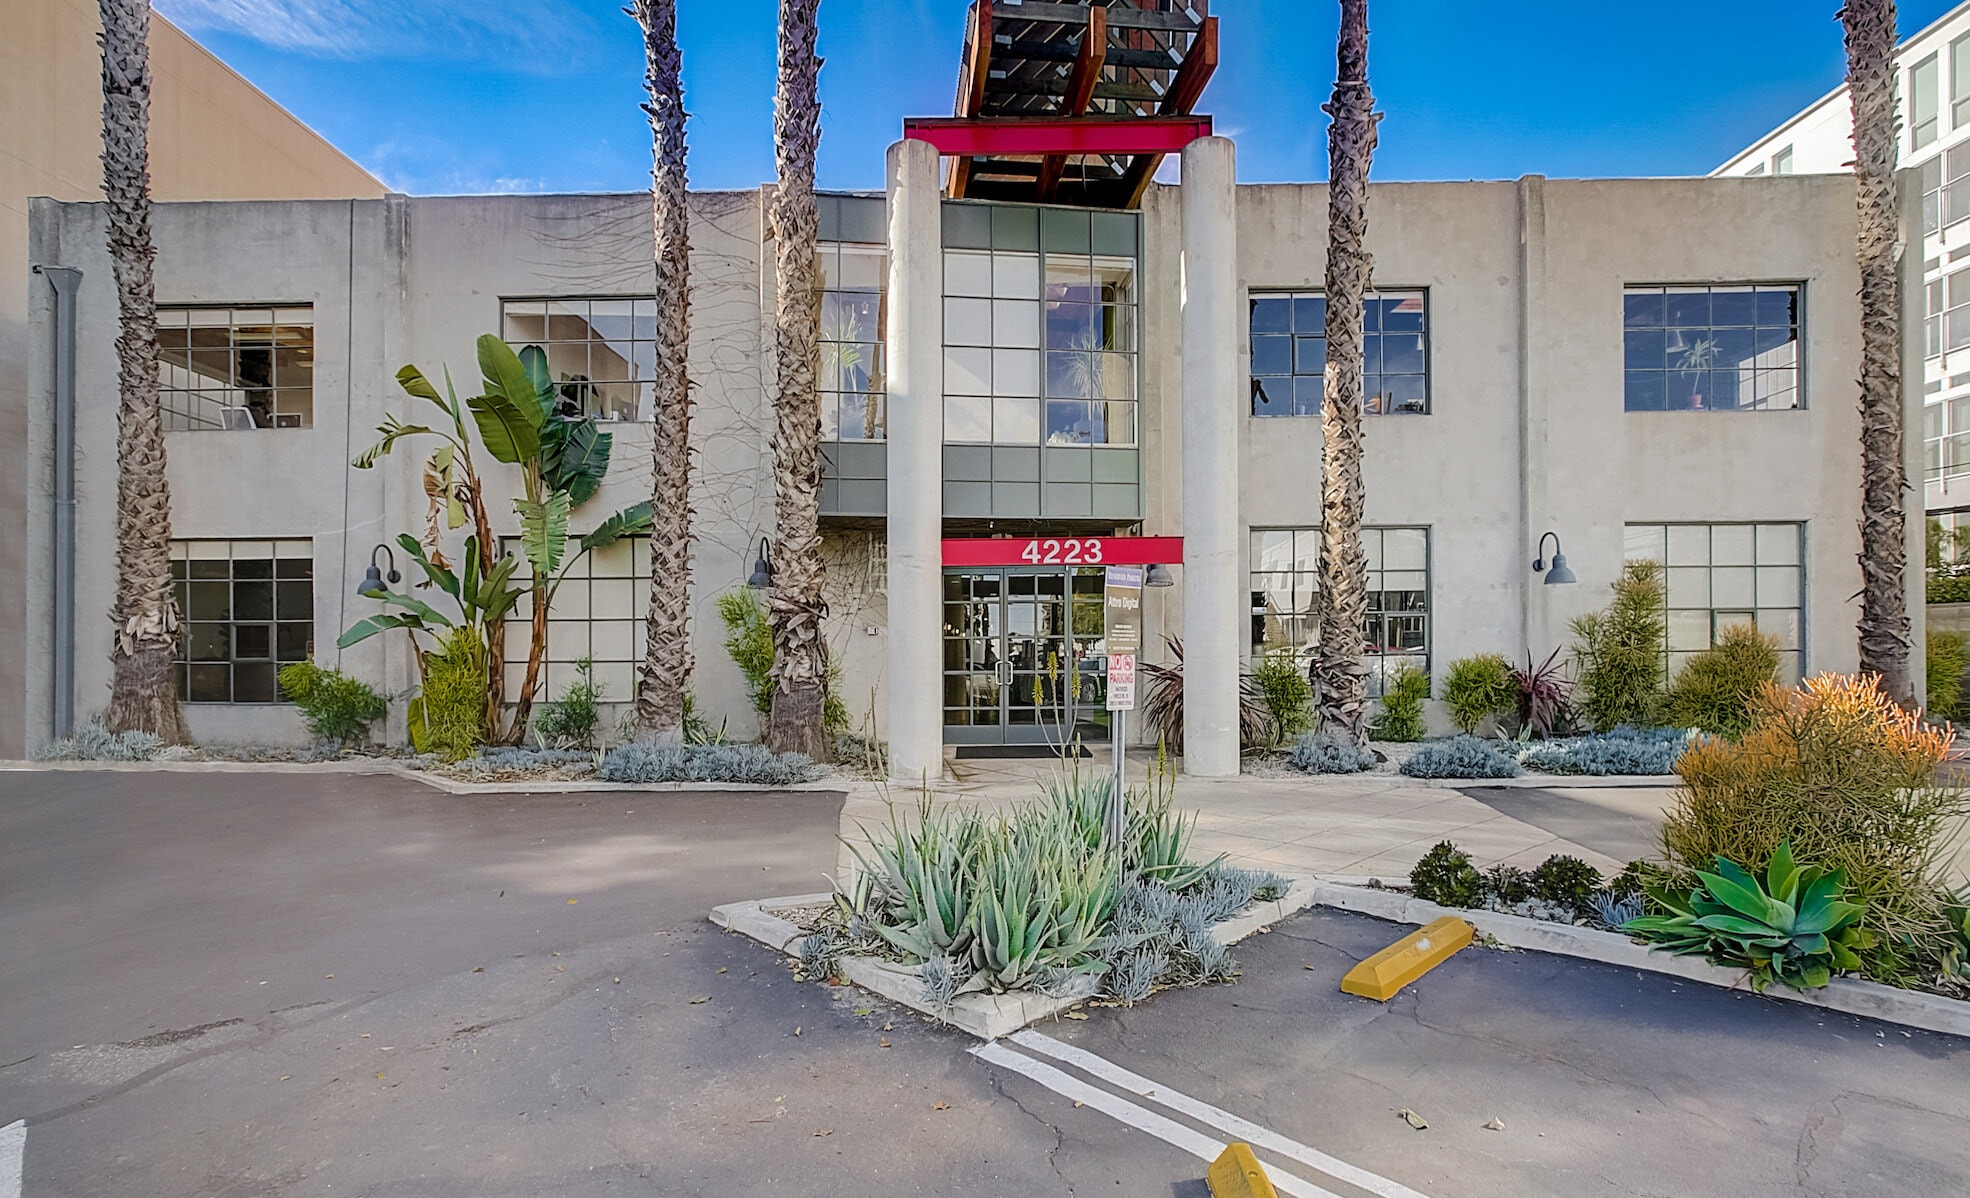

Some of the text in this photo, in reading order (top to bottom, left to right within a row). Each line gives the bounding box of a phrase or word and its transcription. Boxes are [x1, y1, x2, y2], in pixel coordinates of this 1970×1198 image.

[1021, 538, 1103, 564] 4223
[1122, 596, 1139, 611] Digital
[1109, 655, 1121, 670] NO
[1110, 673, 1133, 683] PARKING
